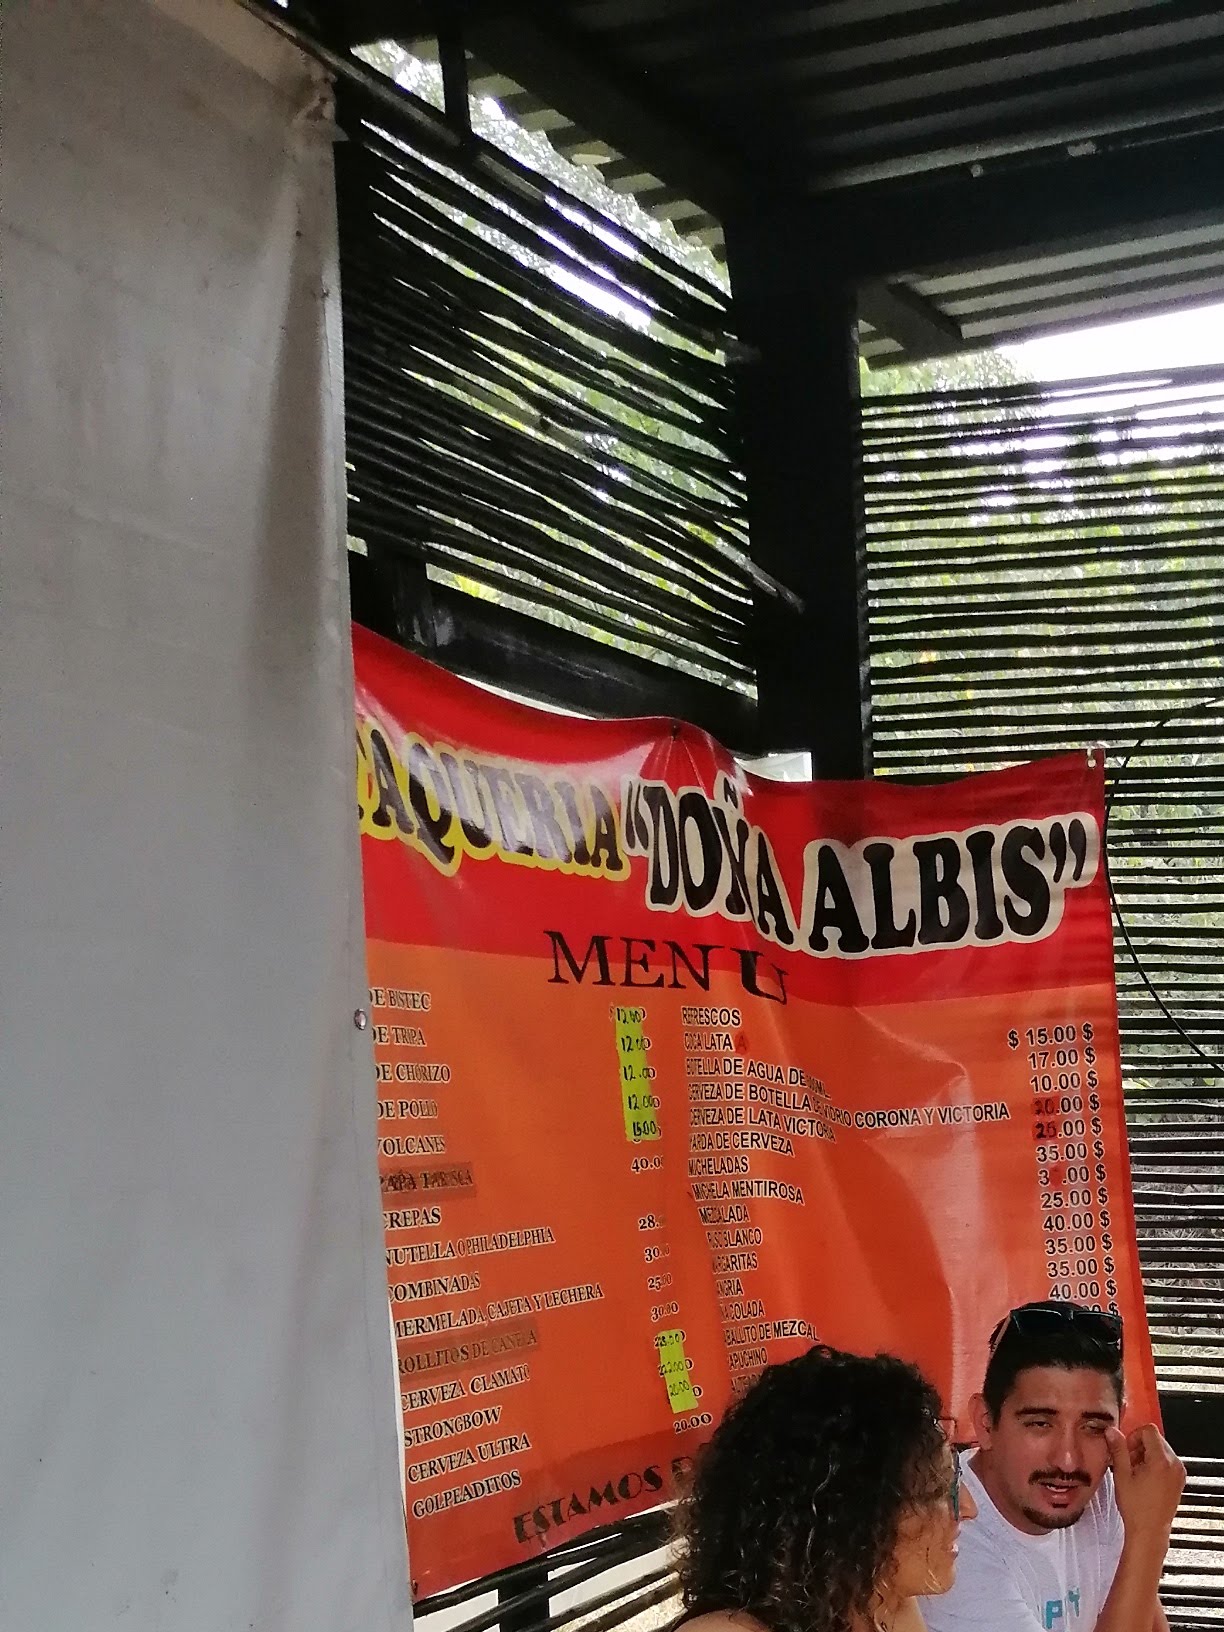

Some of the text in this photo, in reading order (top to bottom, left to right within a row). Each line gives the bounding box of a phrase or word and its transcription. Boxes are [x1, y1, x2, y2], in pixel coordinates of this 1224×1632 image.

[388, 988, 432, 1011] BISTEC
[391, 1027, 427, 1047] TRIPA
[704, 1031, 735, 1052] LATA
[1007, 1030, 1020, 1049] $
[1025, 1026, 1077, 1046] 15.00
[723, 1057, 744, 1076] DE
[747, 1060, 785, 1085] AGUA
[1028, 1050, 1079, 1070] 17.00
[396, 1063, 451, 1083] CHORIZO
[1030, 1073, 1081, 1093] 10.00
[724, 1082, 745, 1101] DE
[748, 1084, 812, 1112] BOTELLA
[854, 1109, 920, 1129] CORONA
[922, 1107, 935, 1125] Y
[936, 1101, 1012, 1124] VICTORIA
[726, 1107, 745, 1125] DE
[748, 1107, 782, 1130] LATA
[715, 1131, 730, 1149] DE
[732, 1131, 796, 1157] CERVEZA
[1036, 1142, 1088, 1163] 35.00
[1038, 1165, 1090, 1186] 3.00
[731, 1179, 805, 1206] MENTIROSA
[1041, 1189, 1092, 1210] 25.00
[1043, 1212, 1094, 1233] 40.00
[457, 1239, 466, 1257] O
[466, 1227, 555, 1256] PHILADELPHIA
[1045, 1234, 1096, 1256] 35.00
[1047, 1257, 1098, 1278] 35.00
[1050, 1279, 1101, 1300] 40.00
[487, 1298, 532, 1320] CAJETA
[532, 1294, 542, 1311] Y
[544, 1284, 605, 1310] LECHERA
[758, 1322, 772, 1340] DE
[772, 1318, 822, 1343] MEZCAL
[403, 1406, 502, 1448] STRONGBOW
[673, 1413, 713, 1434] 20.00
[406, 1433, 532, 1482] CERVEZA ULTRA
[411, 1470, 523, 1519] GOLPEADITOS
[512, 1464, 664, 1543] ESTAMOS
